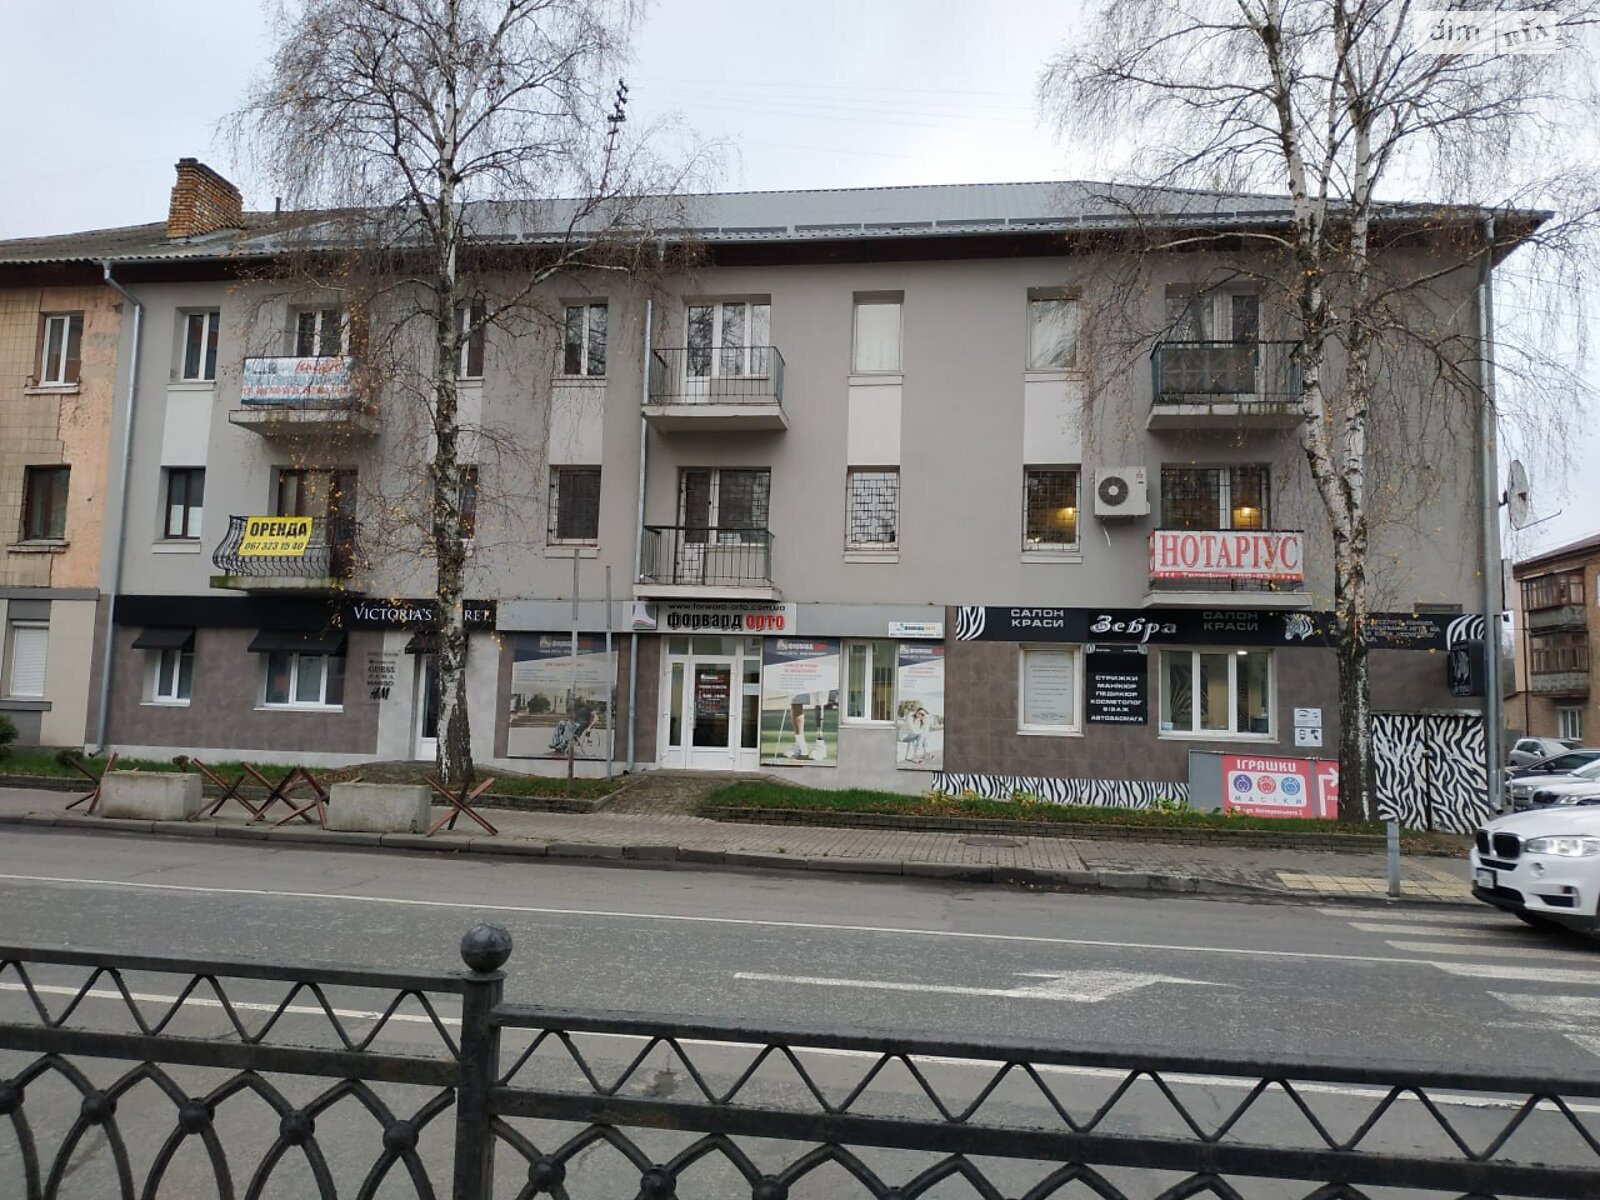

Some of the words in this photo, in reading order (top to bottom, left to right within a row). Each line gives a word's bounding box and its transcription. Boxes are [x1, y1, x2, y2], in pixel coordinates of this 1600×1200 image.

[250, 522, 307, 538] ОРЕНДА
[244, 541, 260, 550] 067
[261, 541, 279, 550] 323
[281, 541, 290, 550] 15
[1159, 534, 1298, 570] НОТАРІУС
[354, 606, 432, 621] VICTORIA'S
[1010, 609, 1064, 617] САЛОН
[1203, 611, 1258, 620] САЛОН
[667, 611, 742, 631] форвард
[745, 613, 785, 631] орто
[1011, 619, 1064, 627] КРАСИ
[1203, 622, 1259, 631] КРАСИ
[1090, 615, 1177, 643] Зебра
[1237, 759, 1296, 772] ІГРАШКИ
